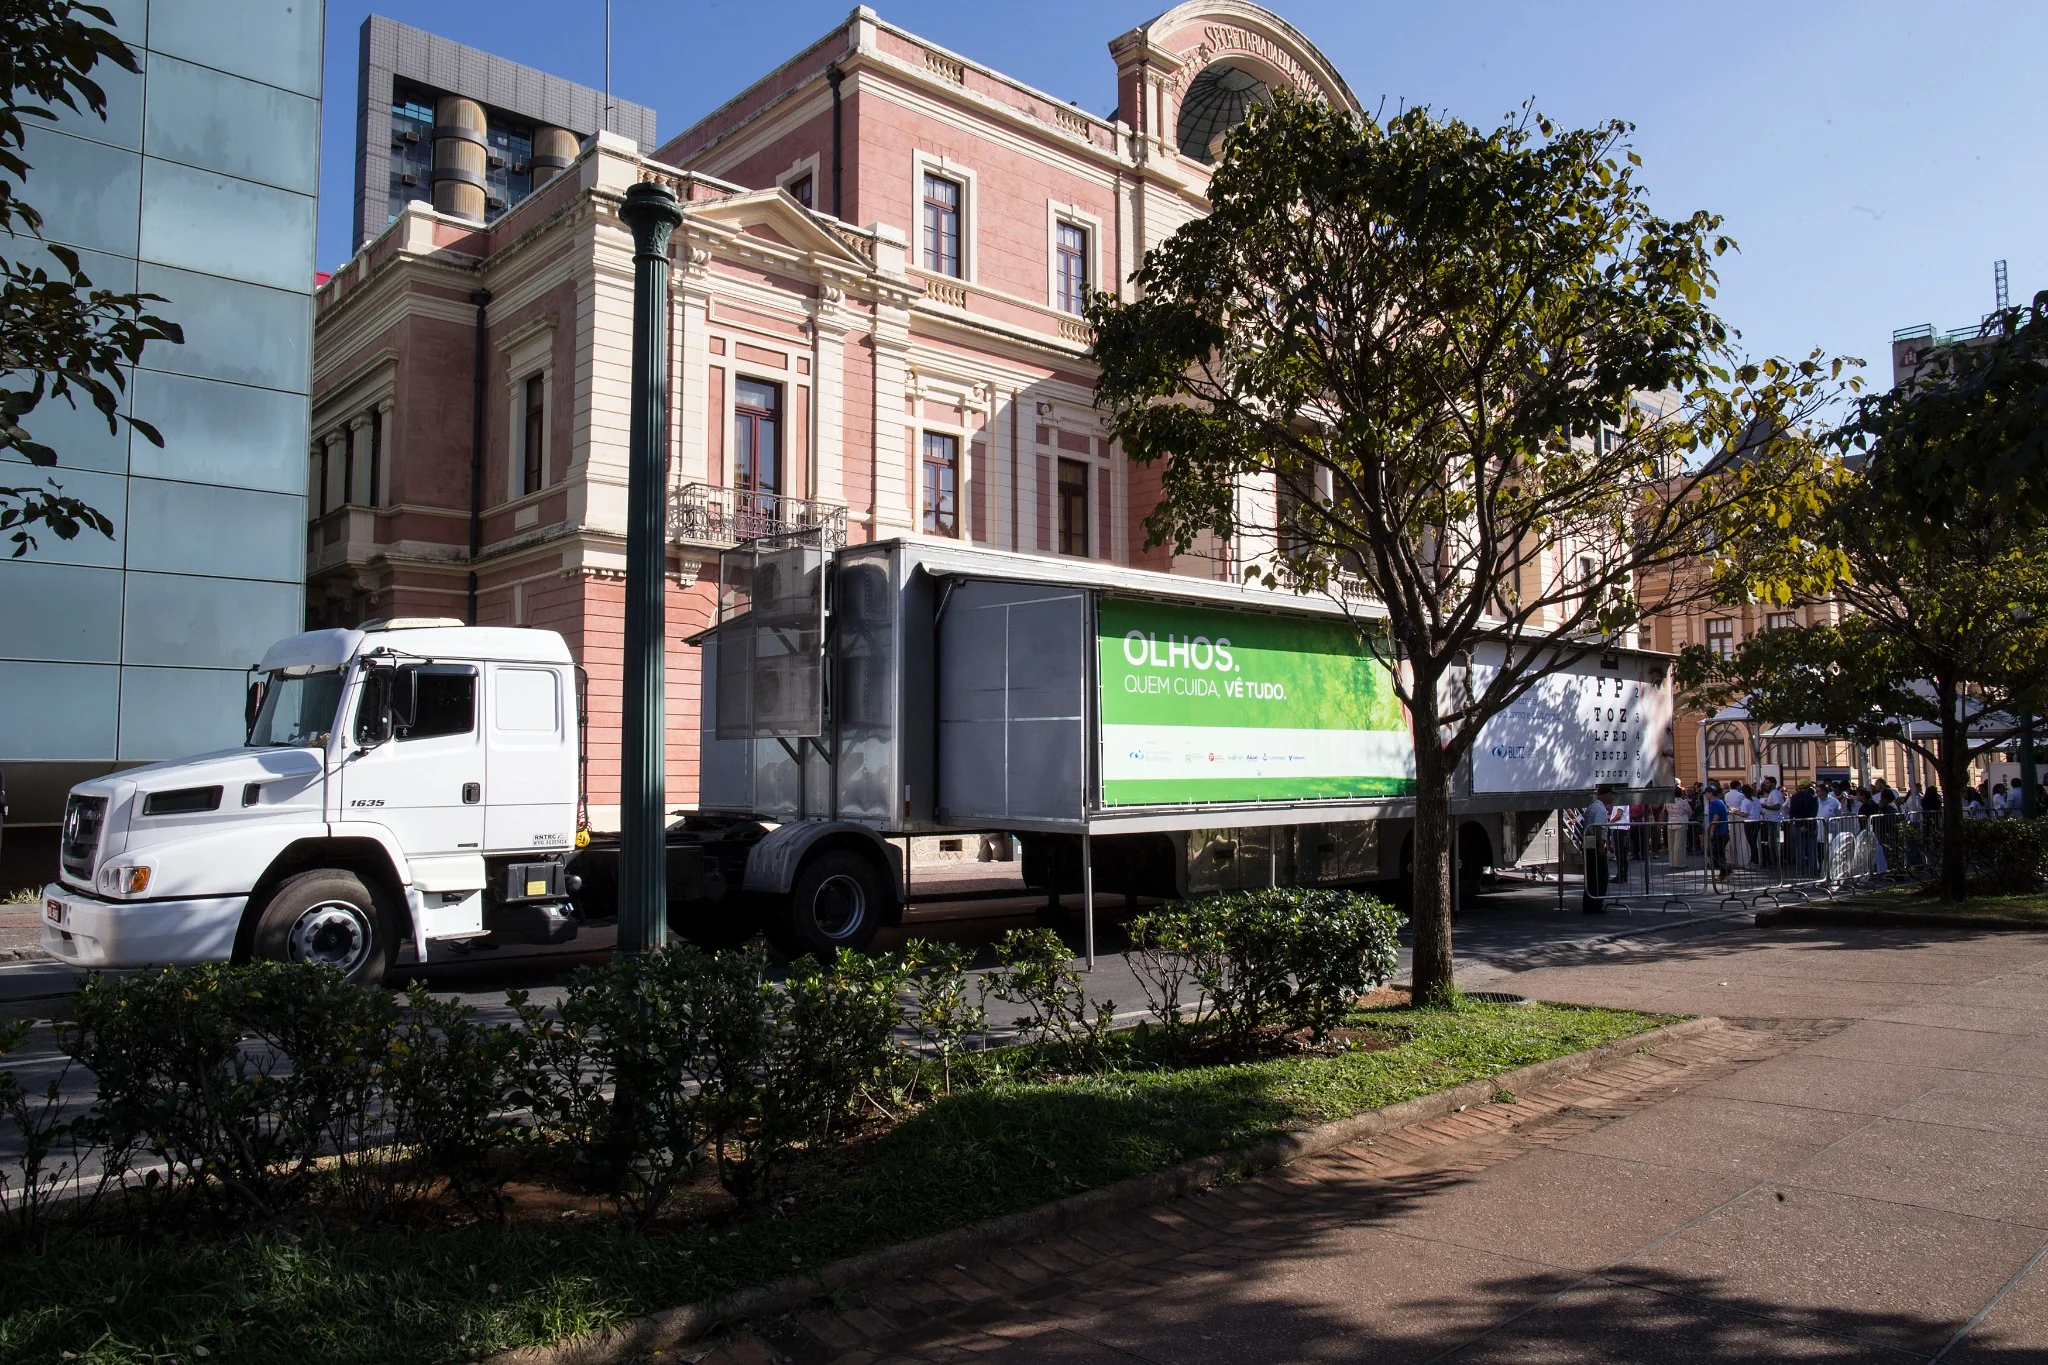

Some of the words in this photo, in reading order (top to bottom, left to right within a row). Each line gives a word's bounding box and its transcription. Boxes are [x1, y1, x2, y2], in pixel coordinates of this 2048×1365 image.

[1205, 25, 1267, 57] SECRETARIA
[1267, 41, 1278, 63] DA
[1123, 630, 1240, 672] OLHOS.
[1124, 674, 1170, 694] QUEM
[1174, 677, 1221, 699] CUIDA,
[1224, 676, 1244, 698] VÊ
[1245, 681, 1287, 700] TUDO.
[1634, 687, 1639, 698] 2
[1635, 713, 1640, 723] 3
[1509, 747, 1525, 759] BLITZ
[1636, 750, 1641, 760] 5
[1636, 769, 1640, 778] 6
[535, 833, 557, 841] RNTRC
